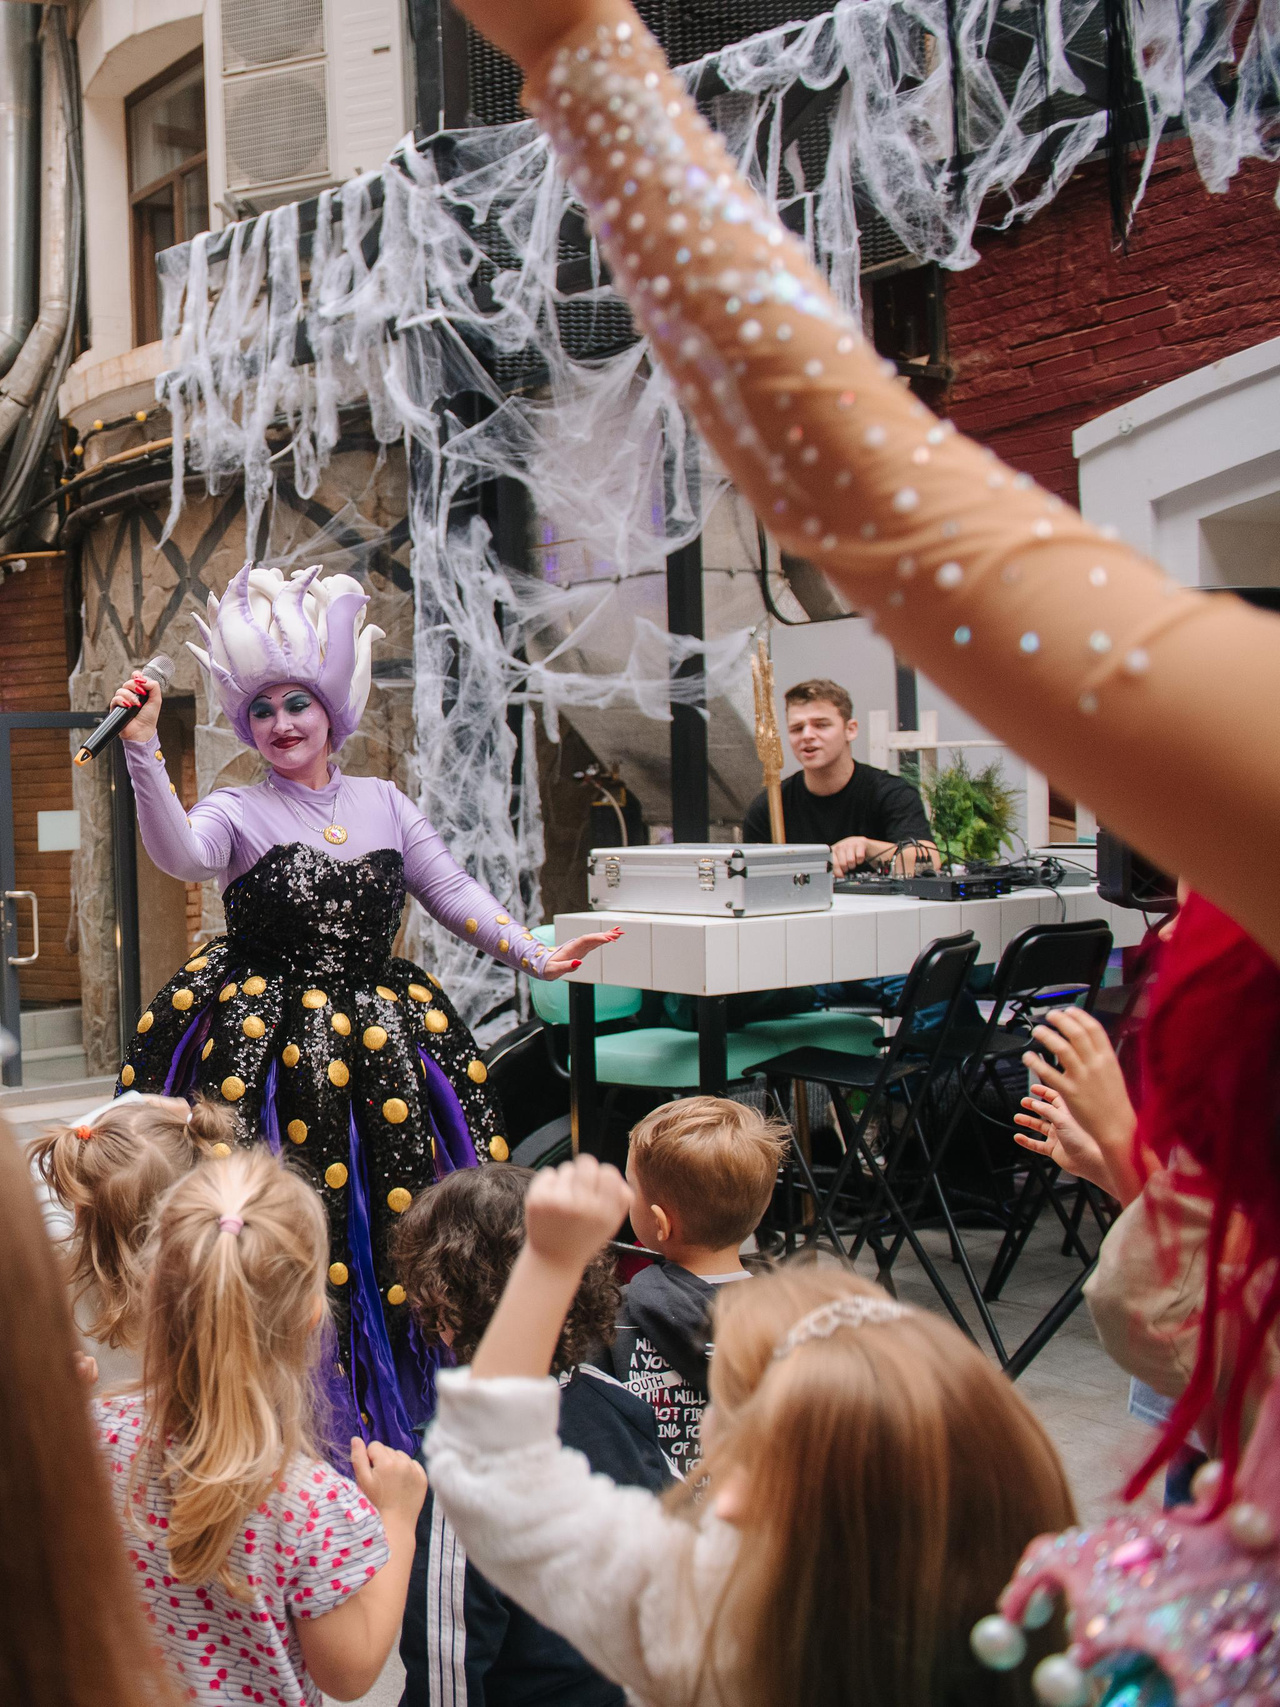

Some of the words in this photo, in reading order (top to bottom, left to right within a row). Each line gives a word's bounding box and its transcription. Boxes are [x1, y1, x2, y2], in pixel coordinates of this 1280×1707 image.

[630, 1352, 639, 1369] A
[663, 1388, 672, 1404] A
[674, 1389, 707, 1405] WILL
[670, 1441, 691, 1456] OF
